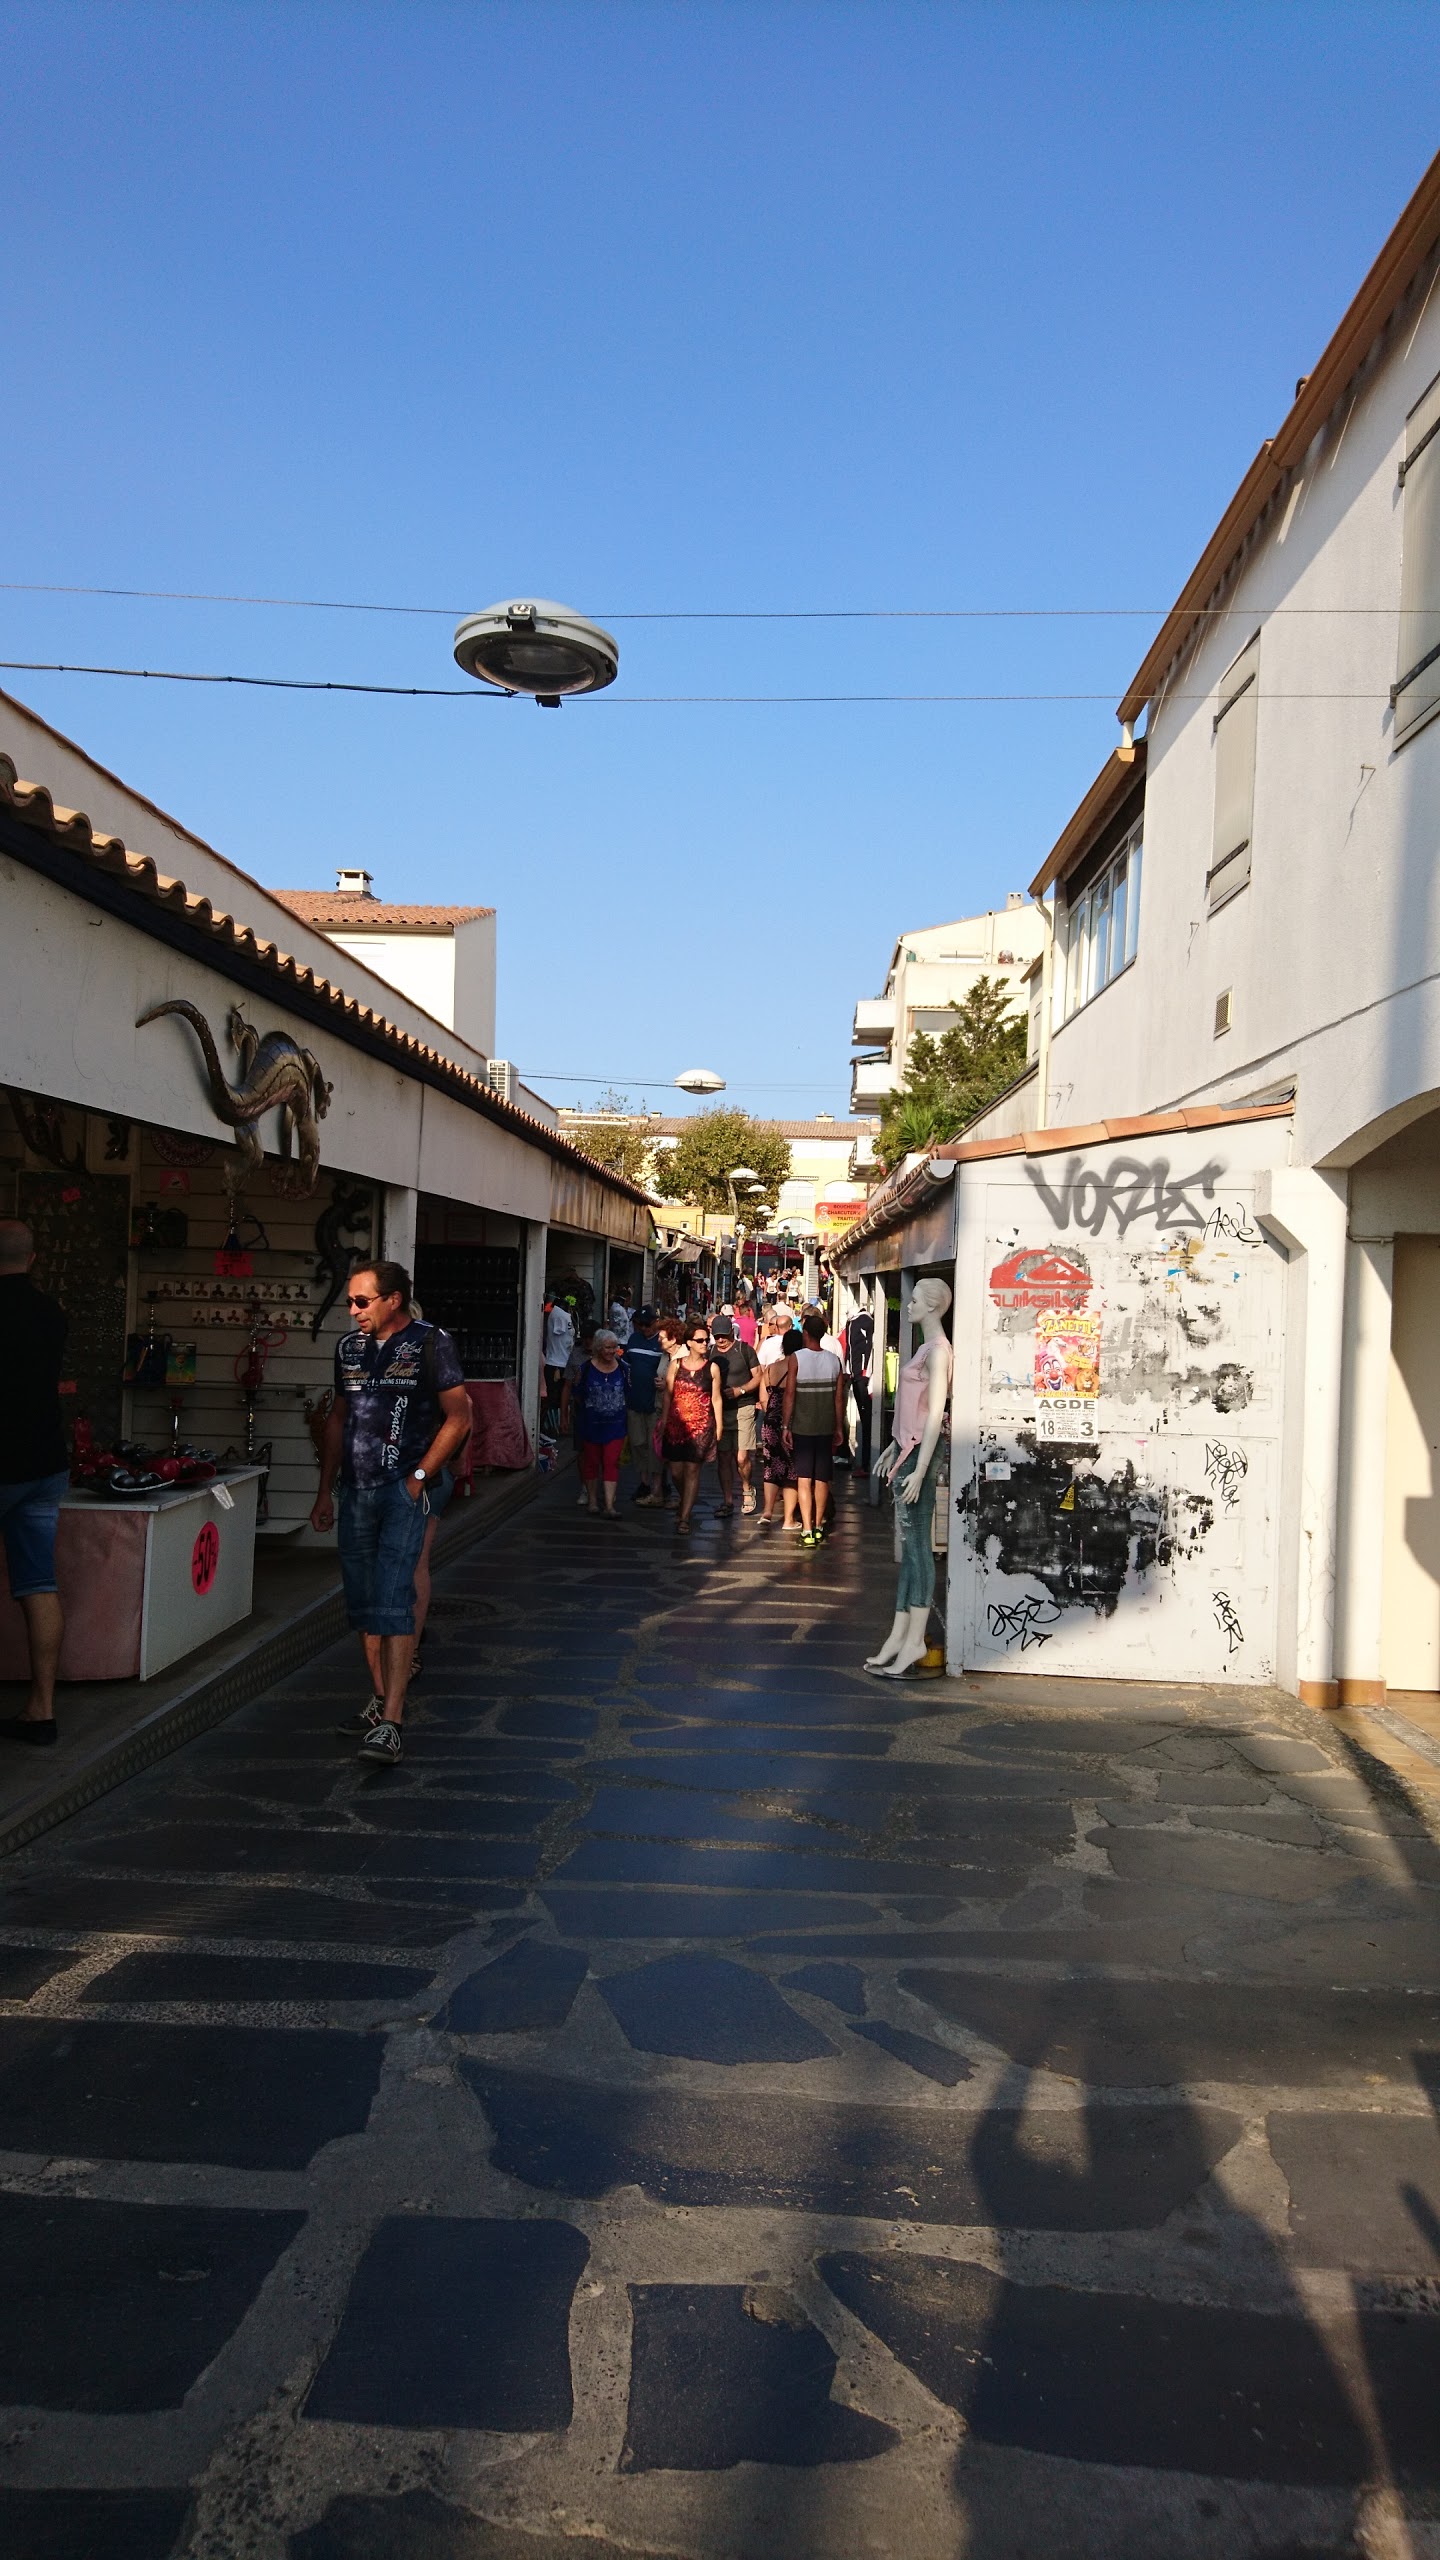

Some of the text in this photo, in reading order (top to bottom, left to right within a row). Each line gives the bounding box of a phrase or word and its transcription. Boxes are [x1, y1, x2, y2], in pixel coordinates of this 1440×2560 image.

[1045, 1319, 1092, 1335] ZANETTI
[1039, 1399, 1095, 1410] AGDE
[390, 1395, 408, 1442] Regatta
[1041, 1420, 1055, 1435] 18
[1080, 1421, 1094, 1437] 3
